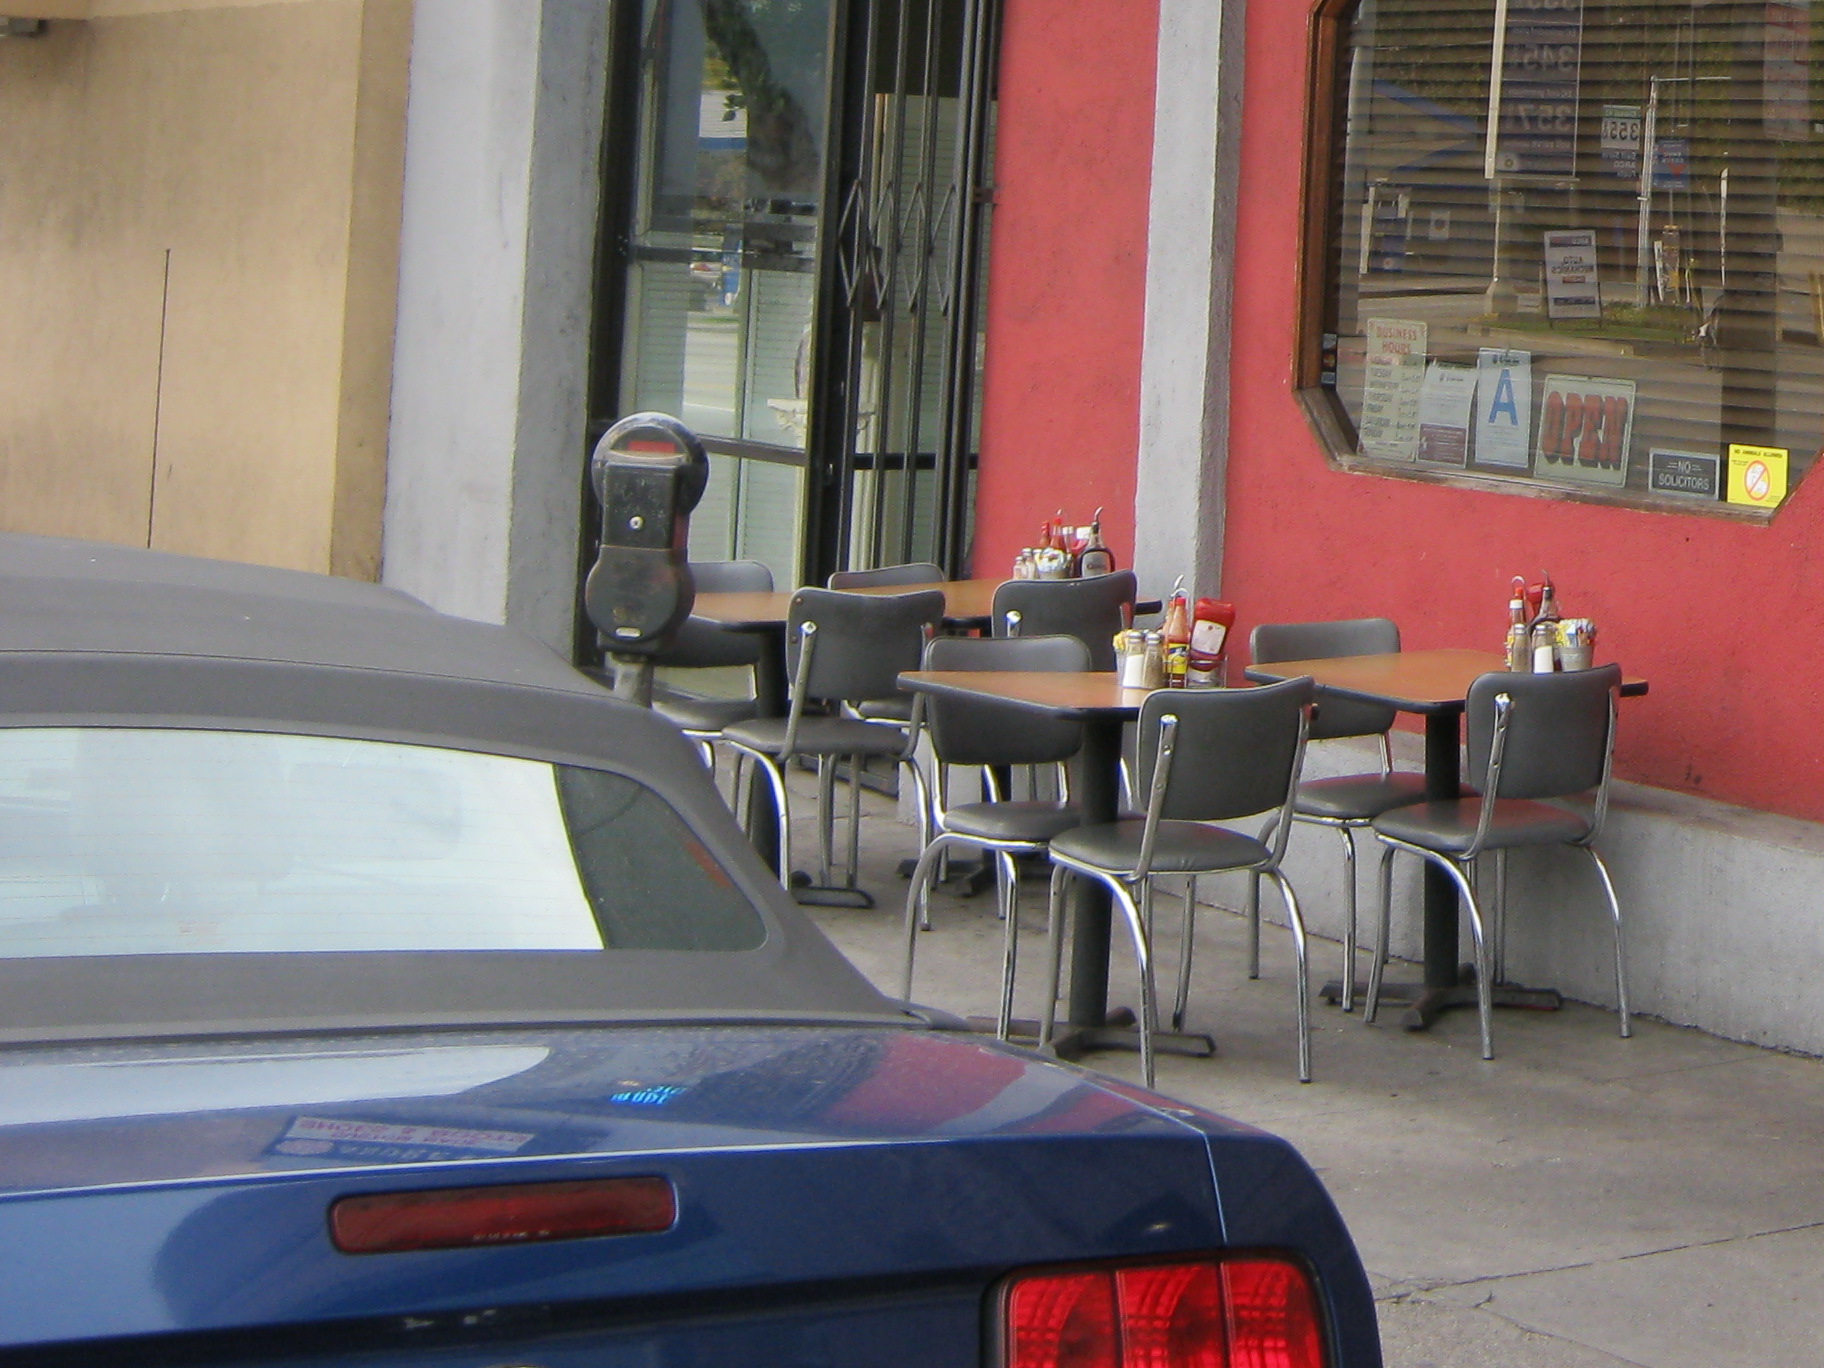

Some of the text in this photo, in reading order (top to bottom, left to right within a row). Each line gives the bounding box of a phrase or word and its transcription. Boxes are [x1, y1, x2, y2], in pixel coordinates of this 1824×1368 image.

[1488, 368, 1519, 426] A
[1542, 390, 1628, 471] OPEN
[1659, 473, 1710, 490] SOLICITORS
[1678, 460, 1692, 474] NO
